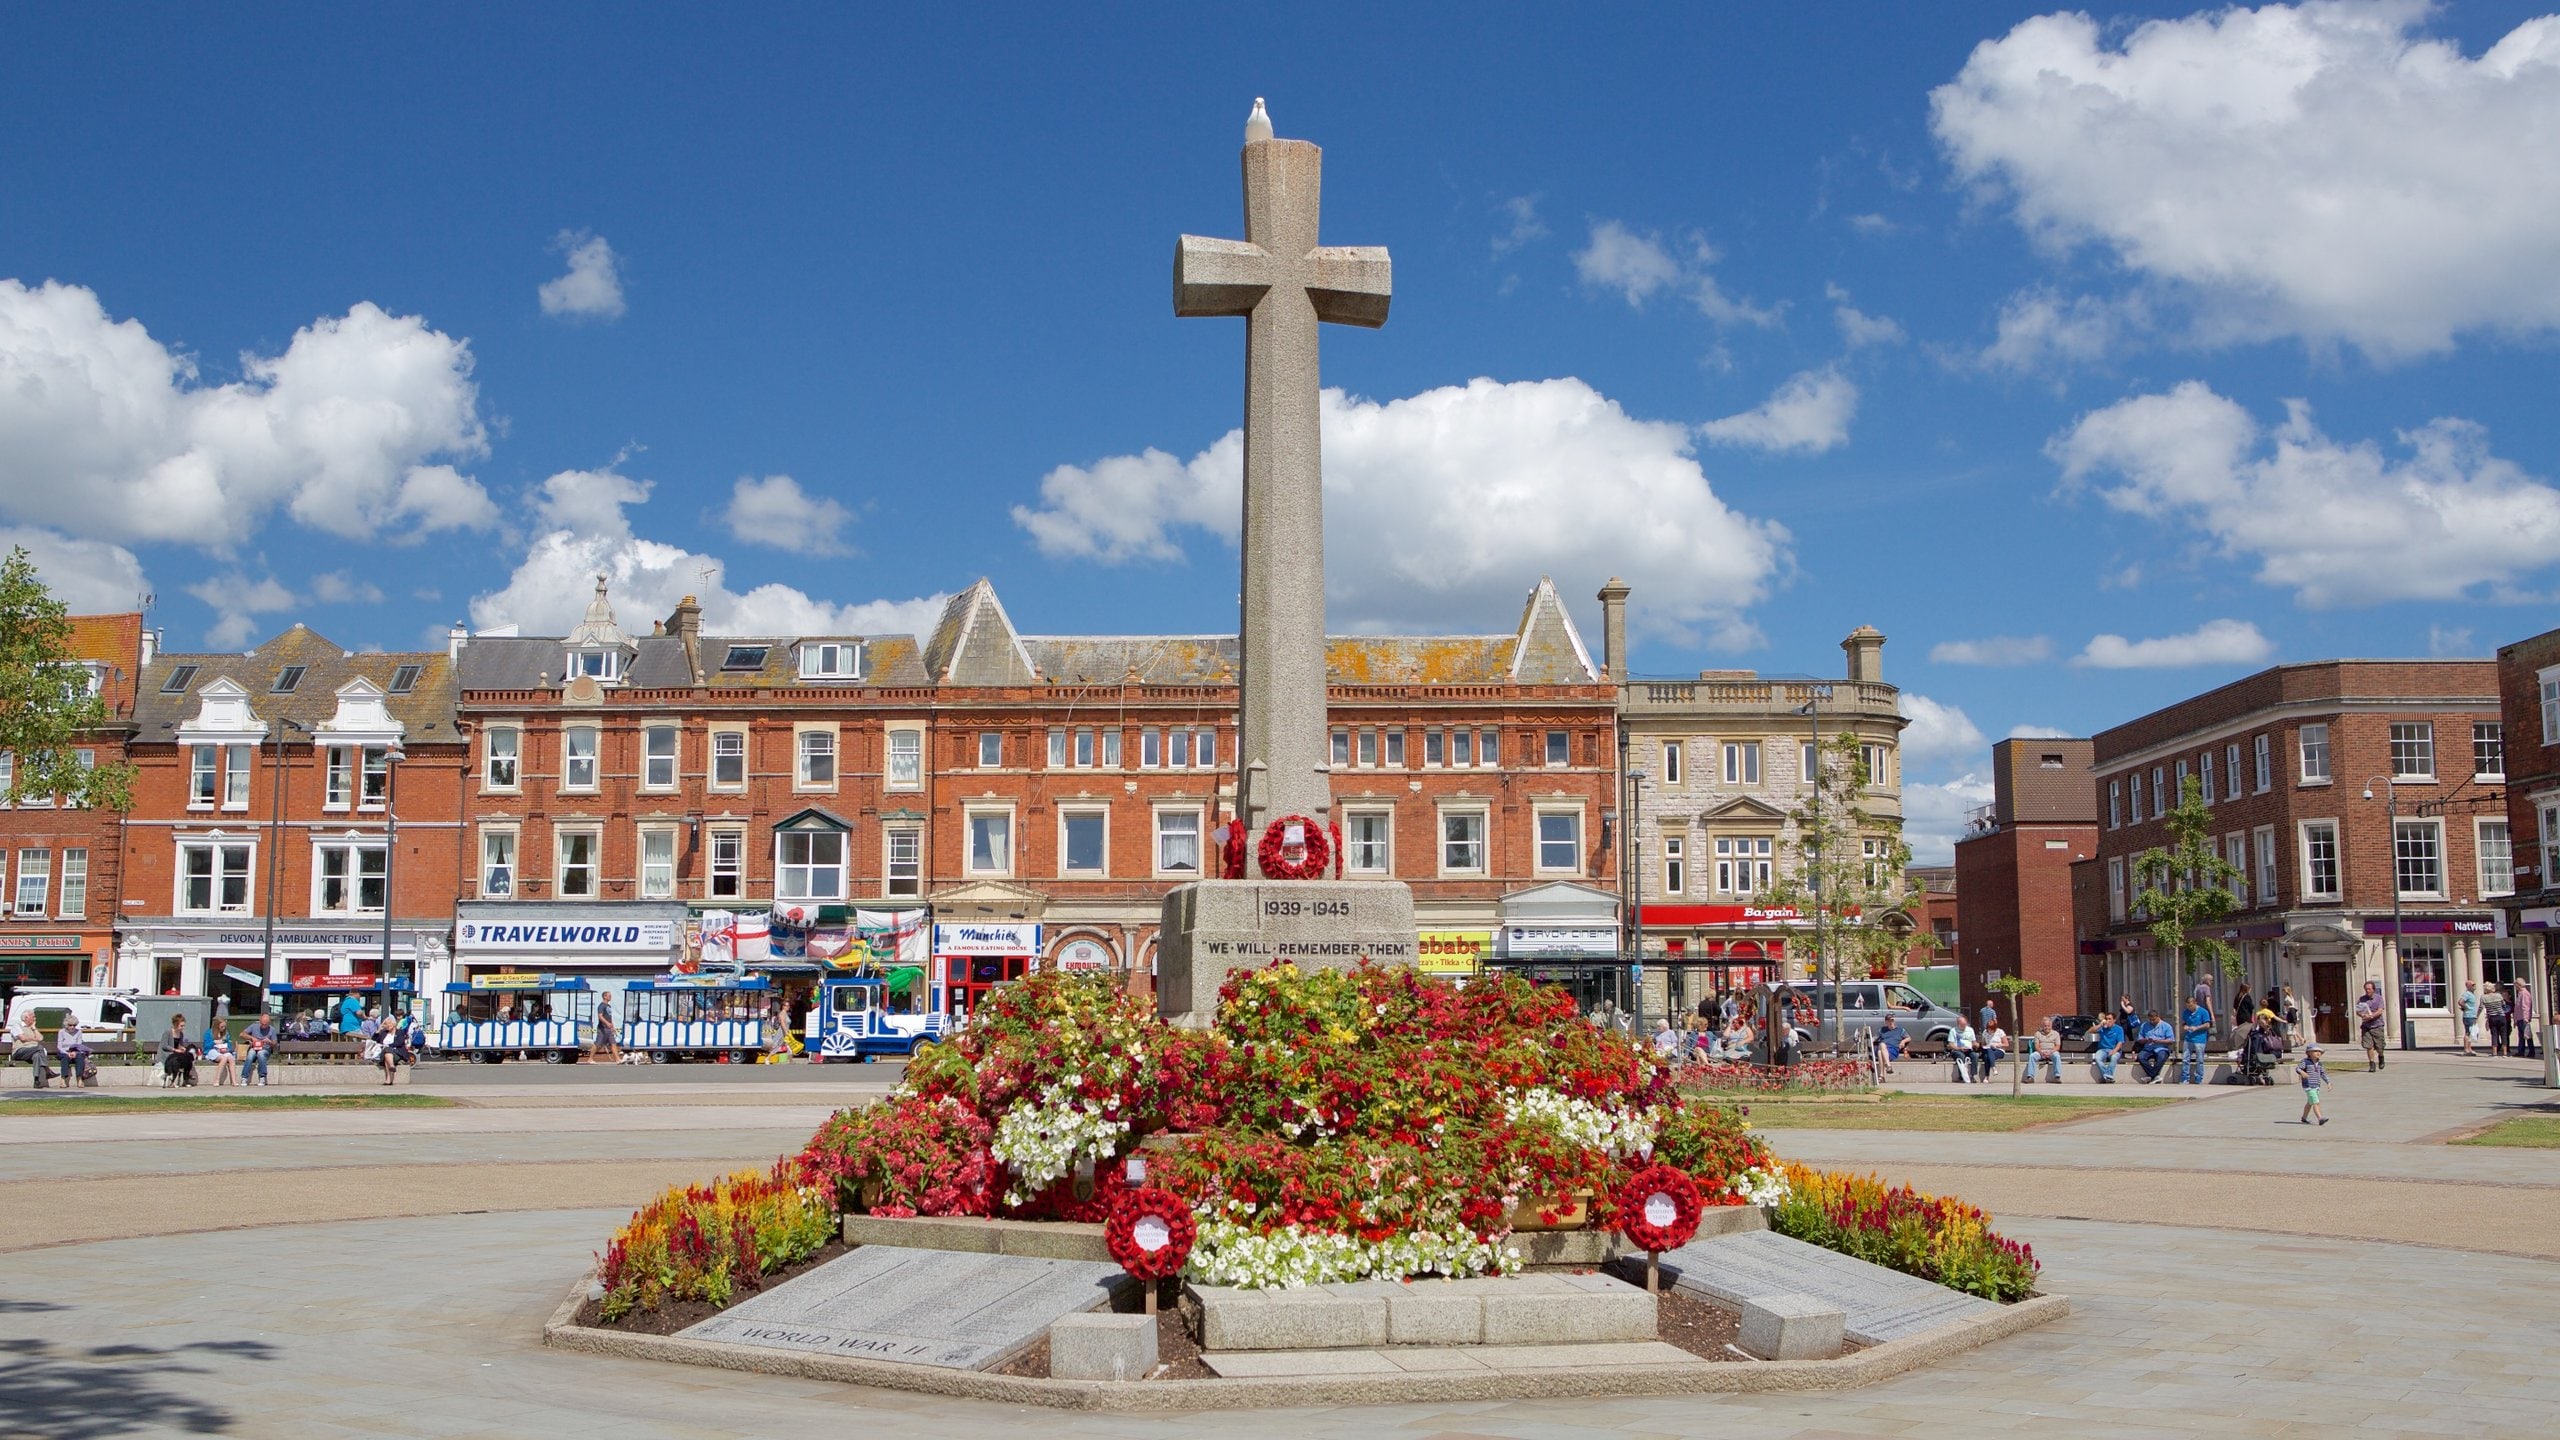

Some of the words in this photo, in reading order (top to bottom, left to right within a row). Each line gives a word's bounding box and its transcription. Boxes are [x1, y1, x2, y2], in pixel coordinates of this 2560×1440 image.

[1743, 907, 1794, 919] Bargain
[2454, 921, 2493, 932] NatWest
[220, 934, 255, 943] DEVON
[277, 934, 339, 944] AMBULANCE
[342, 934, 374, 944] TRUST
[480, 925, 640, 943] TRAVELWORLD
[959, 928, 1017, 942] Munchies
[1528, 930, 1567, 938] SAVOY
[1572, 930, 1613, 938] CINEMA
[36, 938, 75, 947] EATERY
[1419, 935, 1481, 954] ebabs
[1237, 943, 1275, 954] WILL
[1279, 943, 1360, 955] REMEMBER
[742, 1327, 830, 1345] WORLD
[838, 1337, 897, 1352] WAR
[902, 1345, 929, 1355] II
